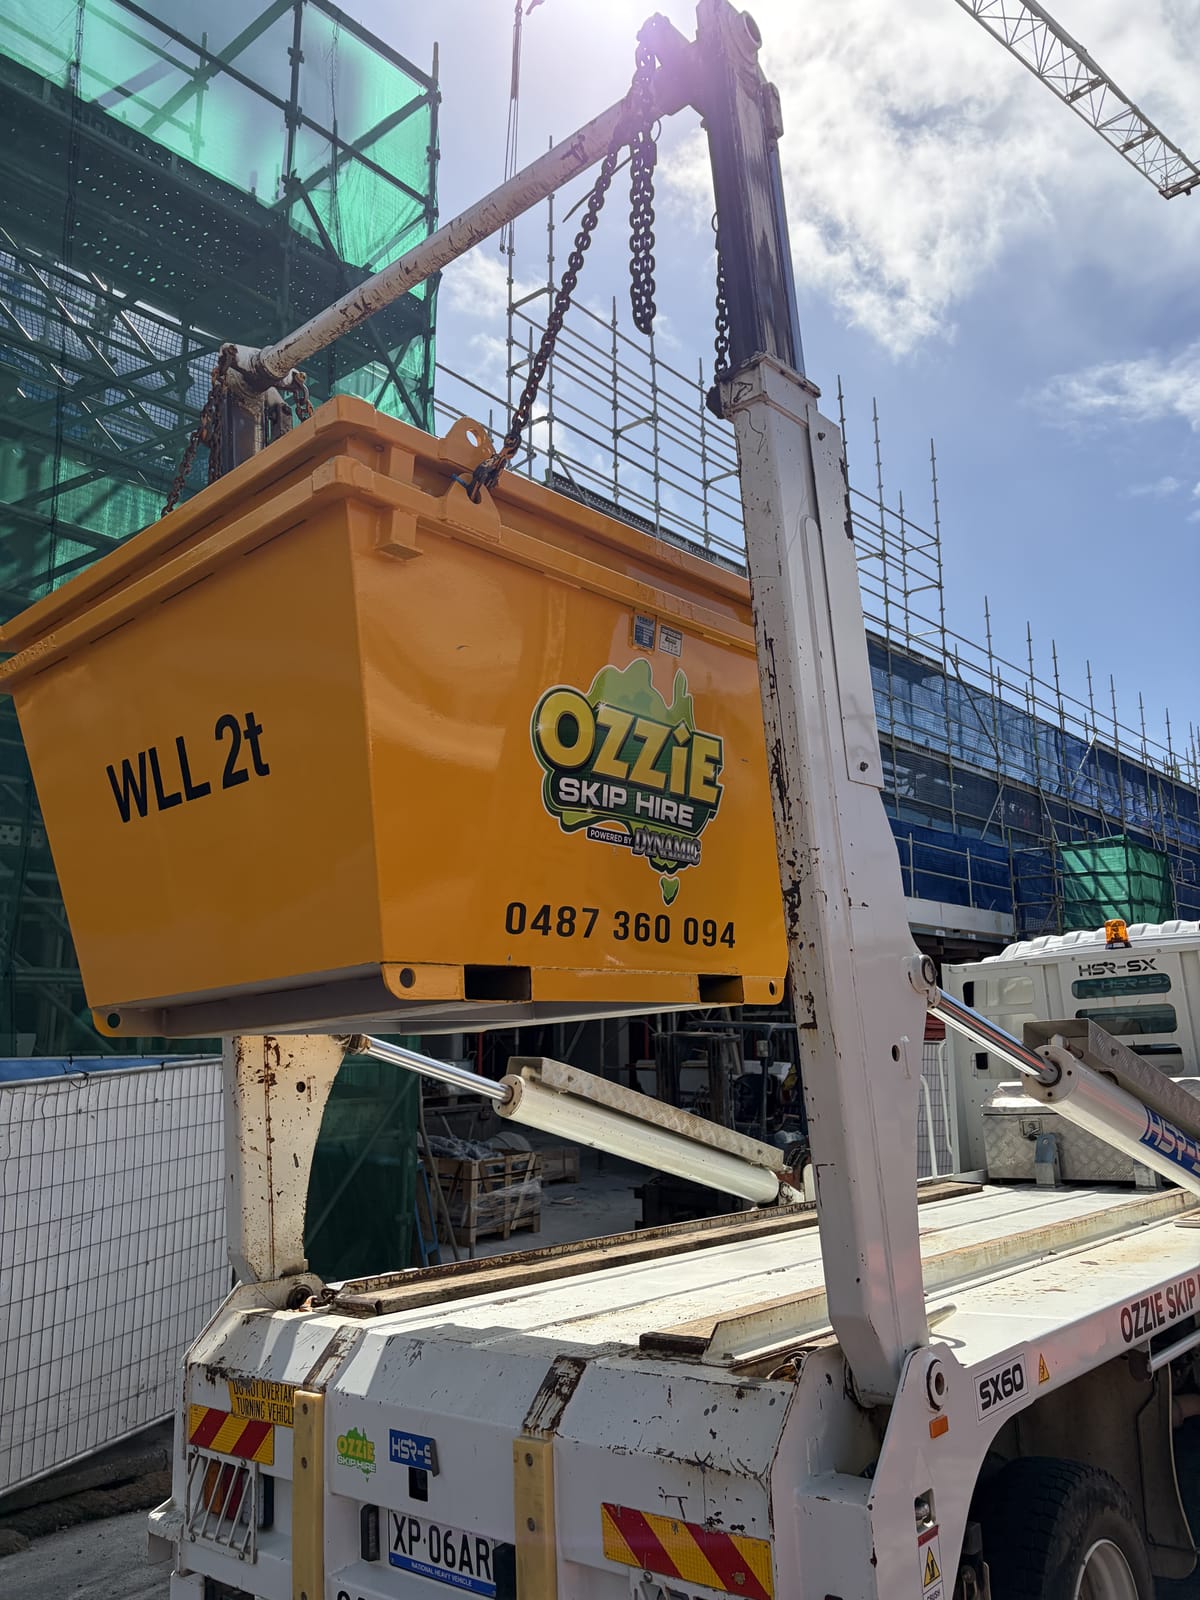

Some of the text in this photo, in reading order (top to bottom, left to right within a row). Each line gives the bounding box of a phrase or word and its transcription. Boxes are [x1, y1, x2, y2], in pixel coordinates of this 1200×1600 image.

[106, 712, 270, 823] WLL 2t
[558, 777, 694, 828] SKIP HIRE
[590, 825, 701, 865] POWERED BY DYNAMIC
[505, 902, 735, 948] 0487 360 094
[1078, 958, 1158, 977] HSR-SX
[1120, 1291, 1166, 1343] OZZIE
[1166, 1277, 1196, 1319] SKIP
[236, 1396, 265, 1420] TURNING
[980, 1363, 1024, 1411] SX60
[338, 1456, 357, 1468] SKIP
[411, 1561, 473, 1587] NATIONAL HEAVY VEHICLE
